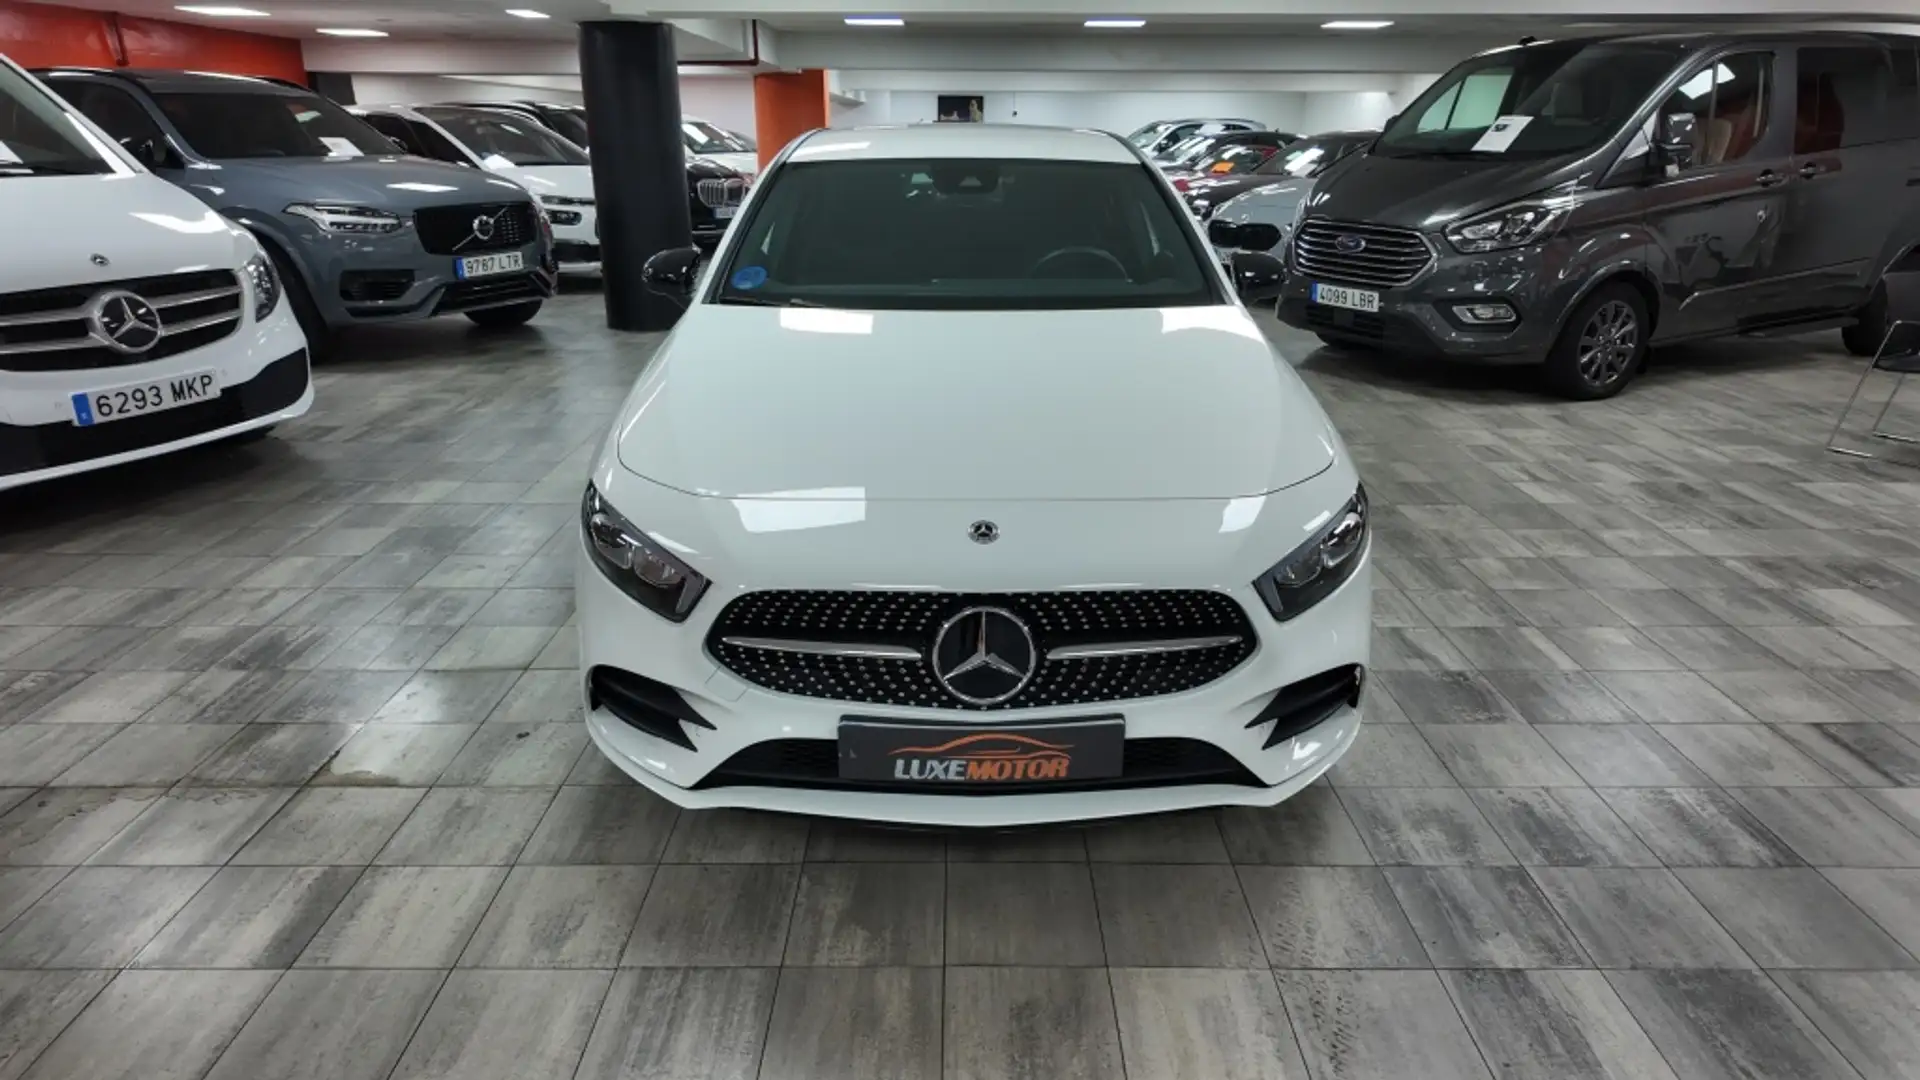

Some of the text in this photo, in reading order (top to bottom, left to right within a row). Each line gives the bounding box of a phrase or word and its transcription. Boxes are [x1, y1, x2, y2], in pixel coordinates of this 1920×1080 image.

[1320, 287, 1376, 309] 4099 LBR
[96, 374, 213, 417] 6293 MKP
[894, 758, 1070, 781] LUXEMOTOR
